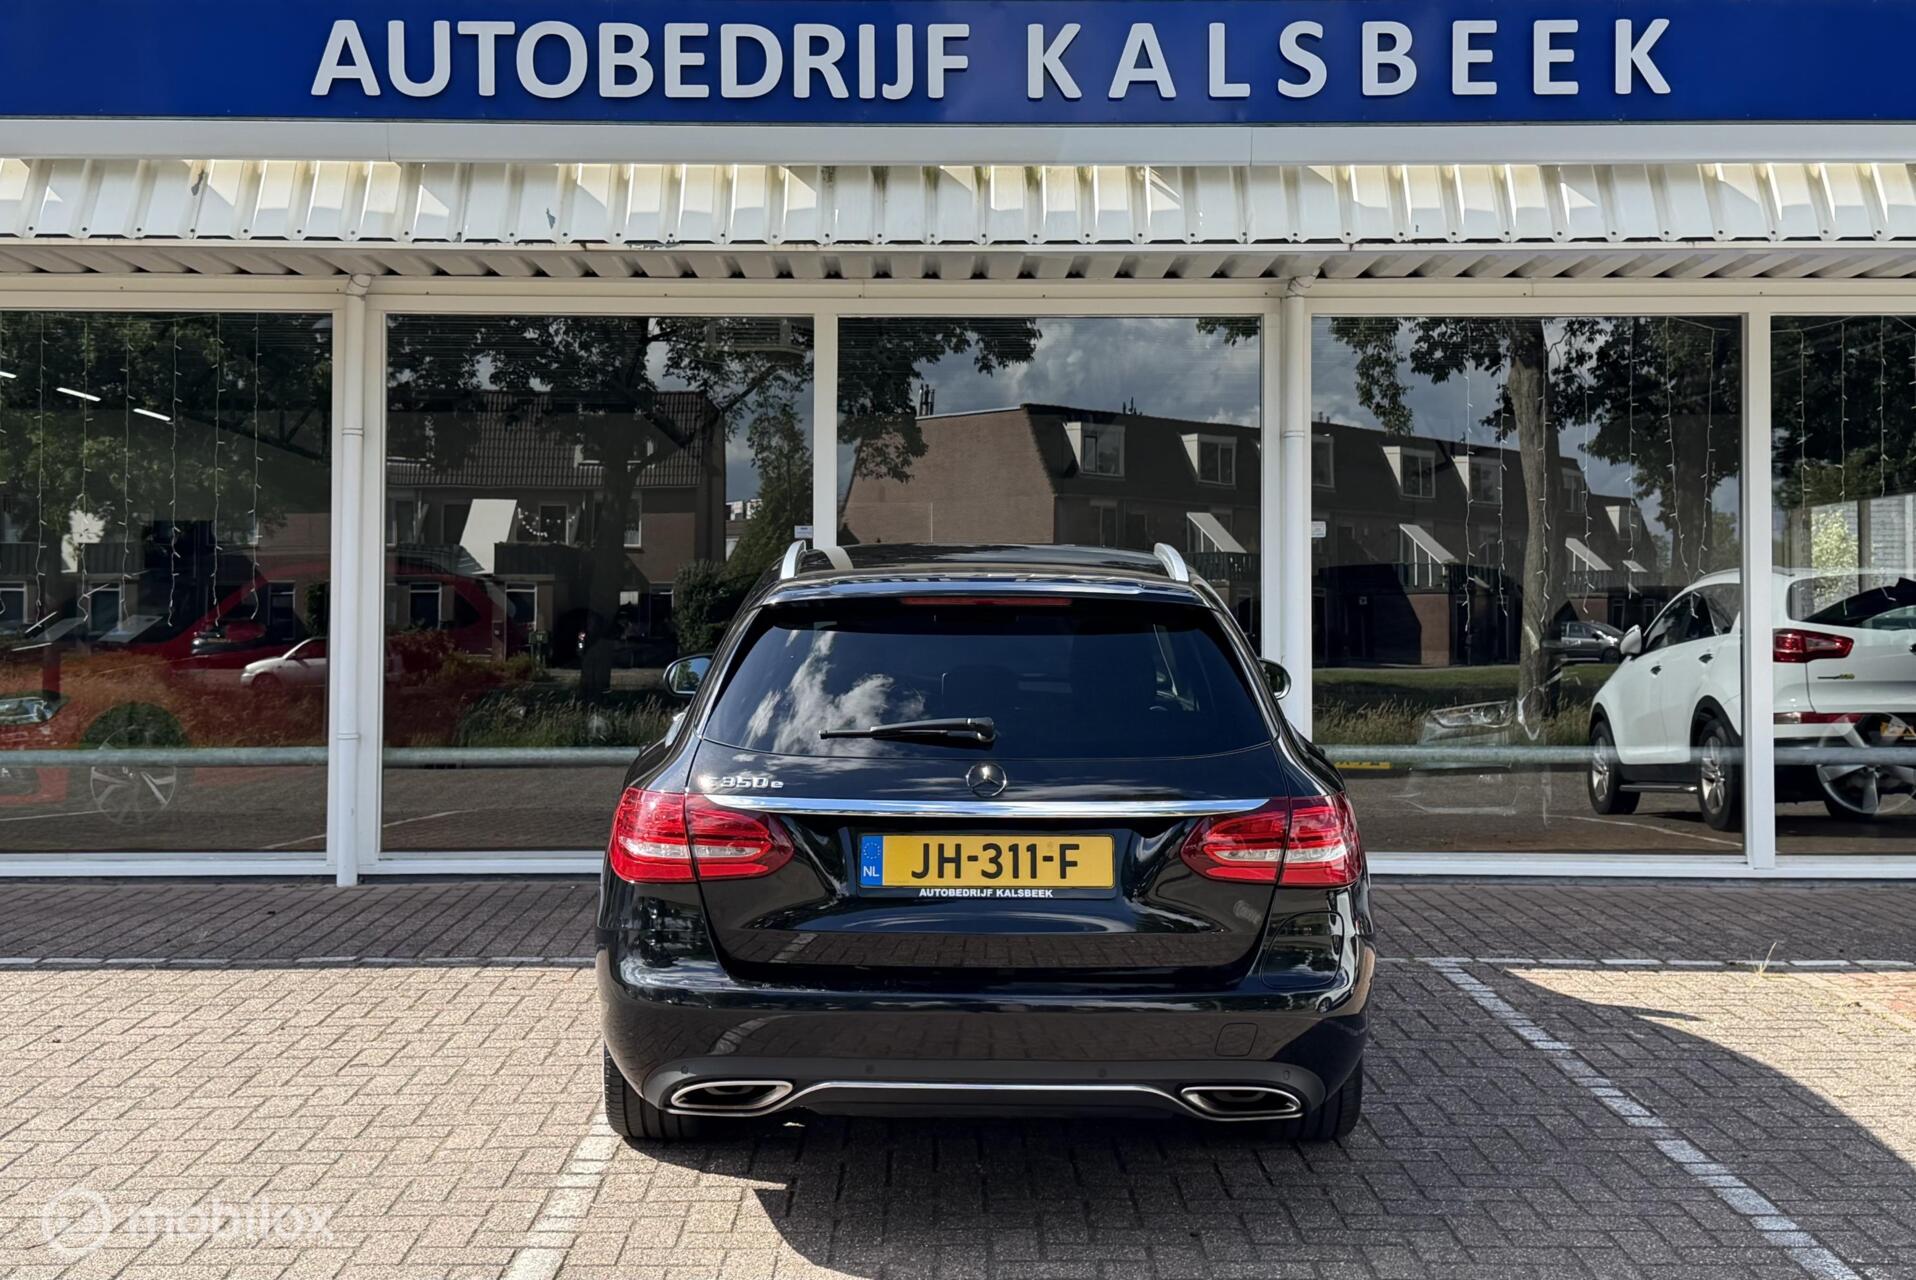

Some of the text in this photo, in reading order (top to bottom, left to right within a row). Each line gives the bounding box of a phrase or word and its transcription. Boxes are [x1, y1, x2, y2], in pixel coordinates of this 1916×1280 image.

[310, 18, 1672, 100] AUTOBEDRIJF KALSBEEK
[863, 865, 880, 877] NL
[911, 843, 1080, 880] JH-311-F
[919, 888, 1053, 898] AUTOBEDRIJF KALSBEEK
